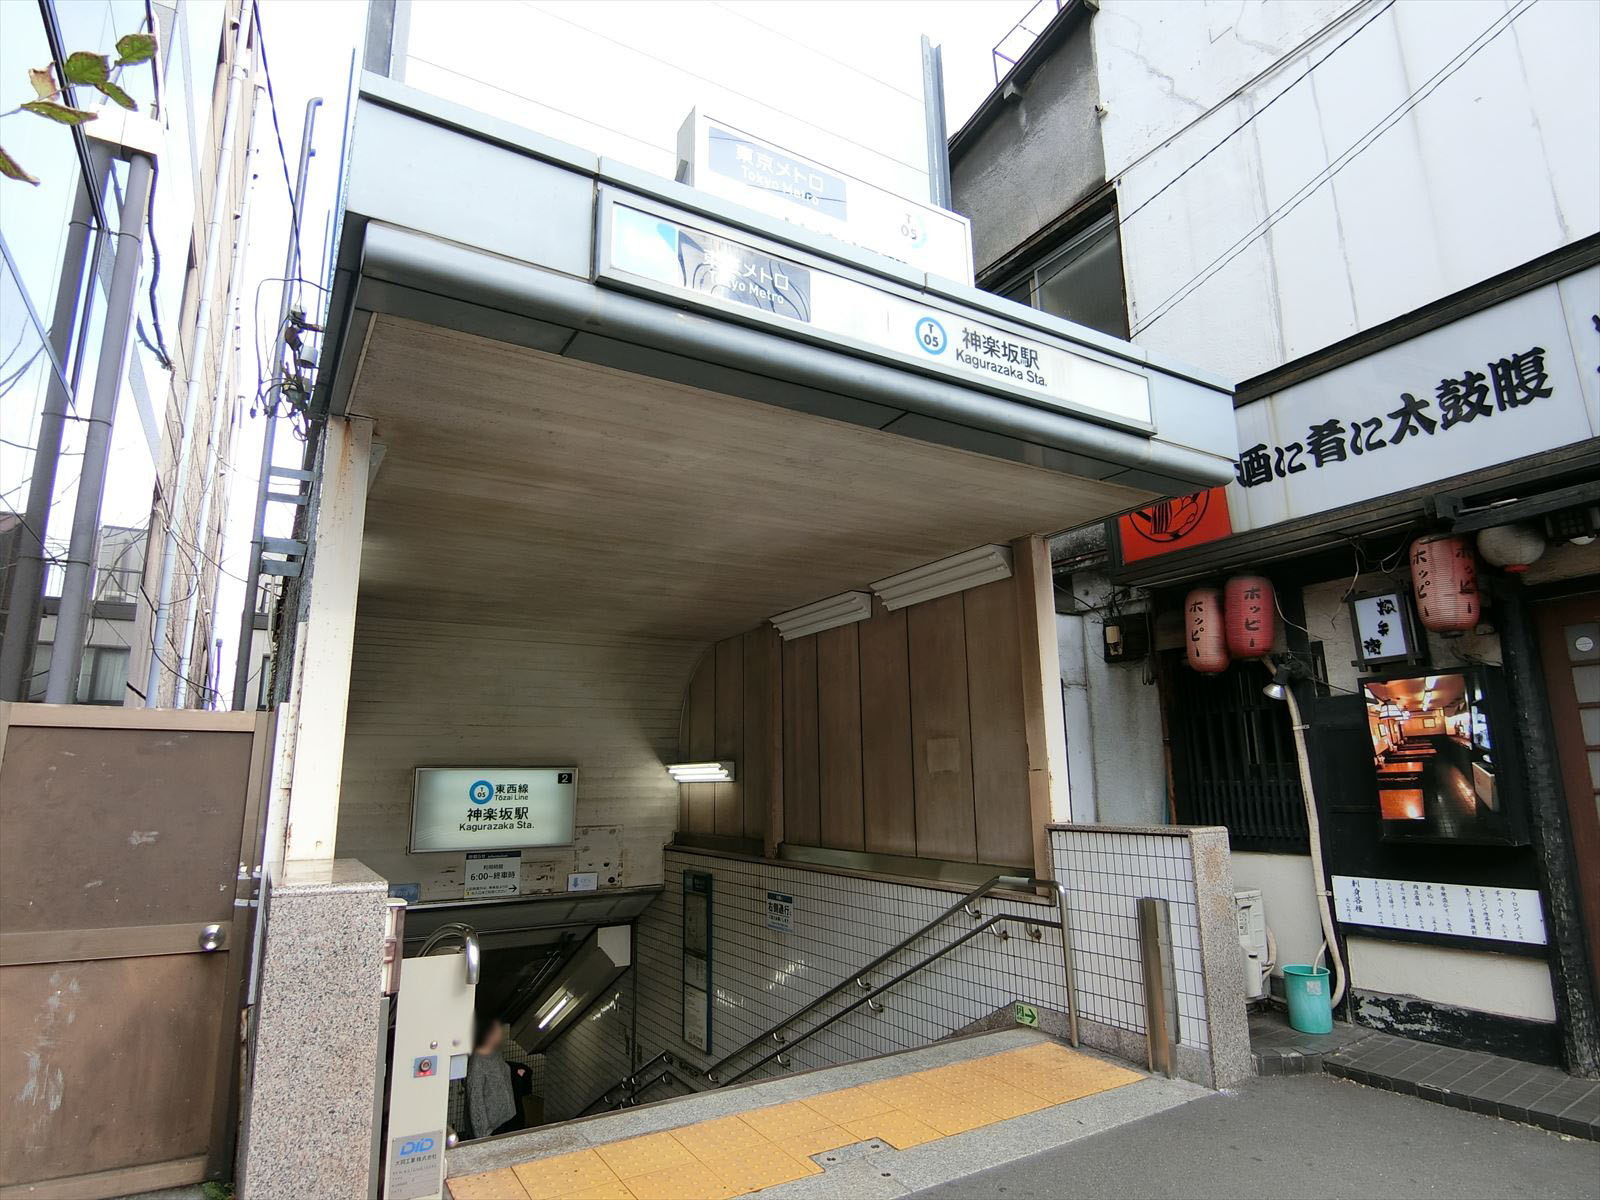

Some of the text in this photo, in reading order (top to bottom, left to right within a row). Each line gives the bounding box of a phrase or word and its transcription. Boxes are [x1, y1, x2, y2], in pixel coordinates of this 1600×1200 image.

[736, 145, 824, 192] 東京メトロ
[741, 165, 780, 191] Tokyo
[900, 224, 918, 240] 05
[904, 213, 912, 224] T
[704, 249, 788, 290] メトロ
[711, 268, 784, 304] Tyo Metro
[924, 334, 939, 348] 05
[928, 323, 934, 333] T
[962, 327, 1040, 370] 神楽坂駅
[956, 348, 1047, 387] Kagurazaka Sta.
[1234, 346, 1554, 488] 酒に肴に太鼓腹
[1413, 548, 1431, 618] ホッピー
[1189, 599, 1205, 658] ホッピー
[1244, 586, 1262, 648] ホッピー
[495, 783, 529, 794] 東西線
[561, 774, 569, 783] 2
[459, 820, 535, 832] Kagurazaka Sta.
[467, 807, 529, 821] 神楽坂駅
[1352, 880, 1363, 913] 刺身各種
[1495, 890, 1504, 919] チューハイ
[1510, 891, 1521, 921] ウーロンハイ
